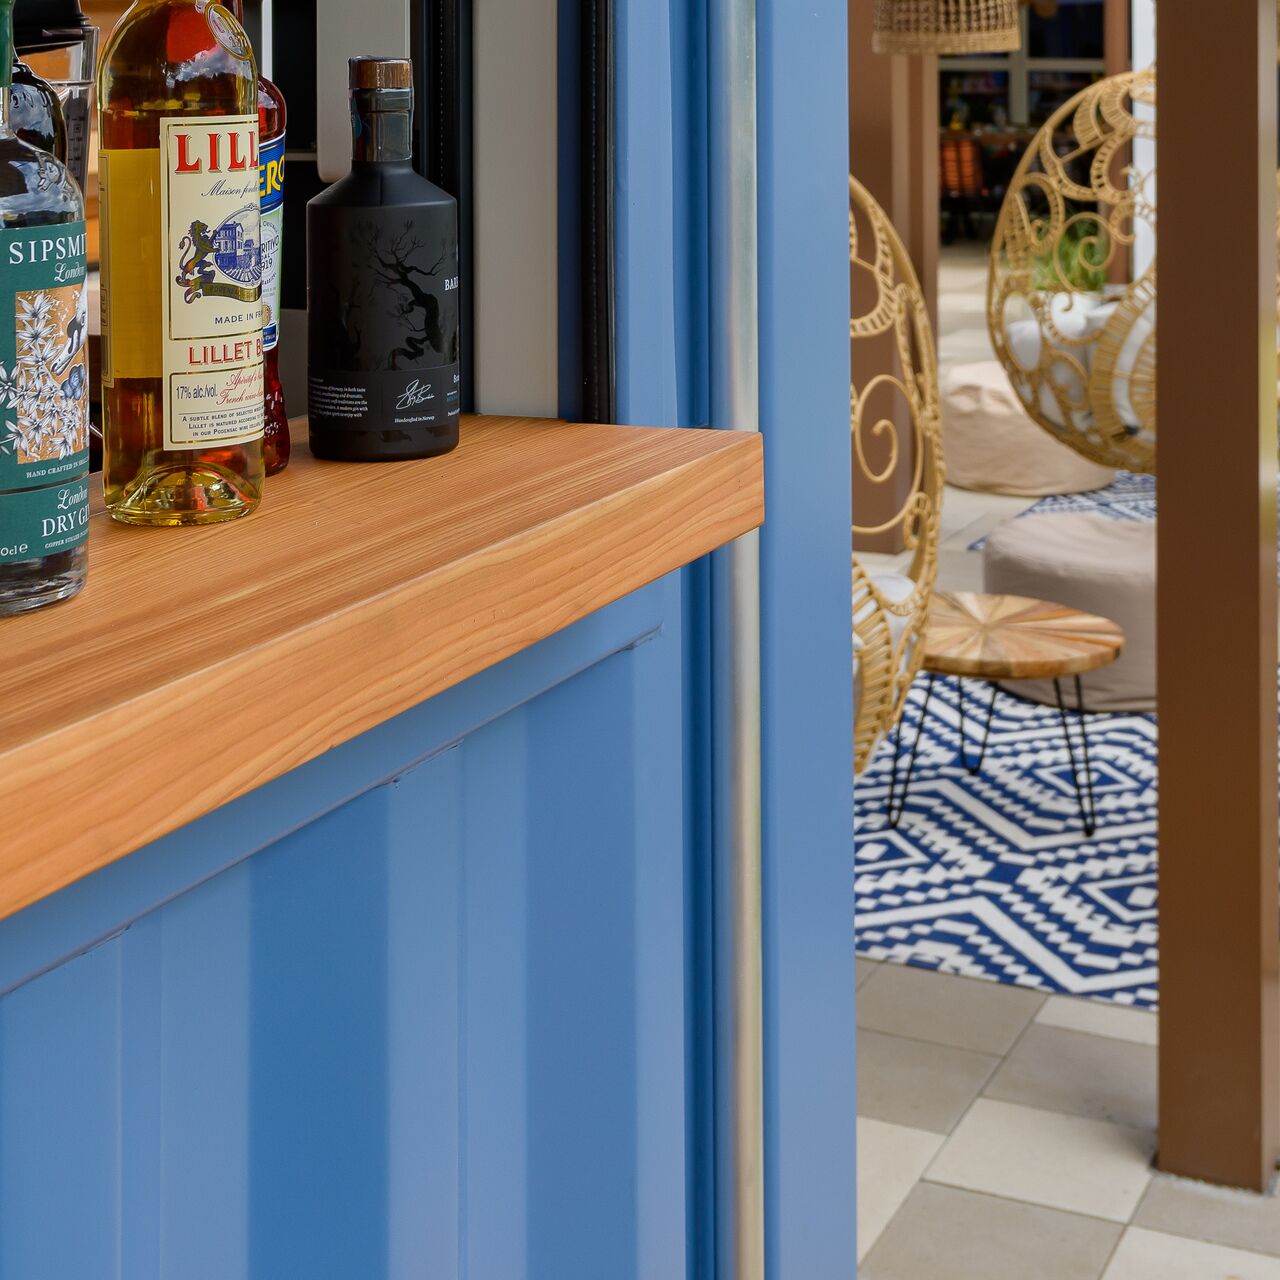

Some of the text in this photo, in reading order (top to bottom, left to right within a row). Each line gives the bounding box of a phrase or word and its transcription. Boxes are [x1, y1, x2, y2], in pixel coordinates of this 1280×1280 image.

[215, 314, 244, 325] MADE
[246, 312, 254, 320] IN
[188, 341, 252, 365] LILLET
[26, 469, 47, 478] HAND
[41, 510, 77, 537] DRY
